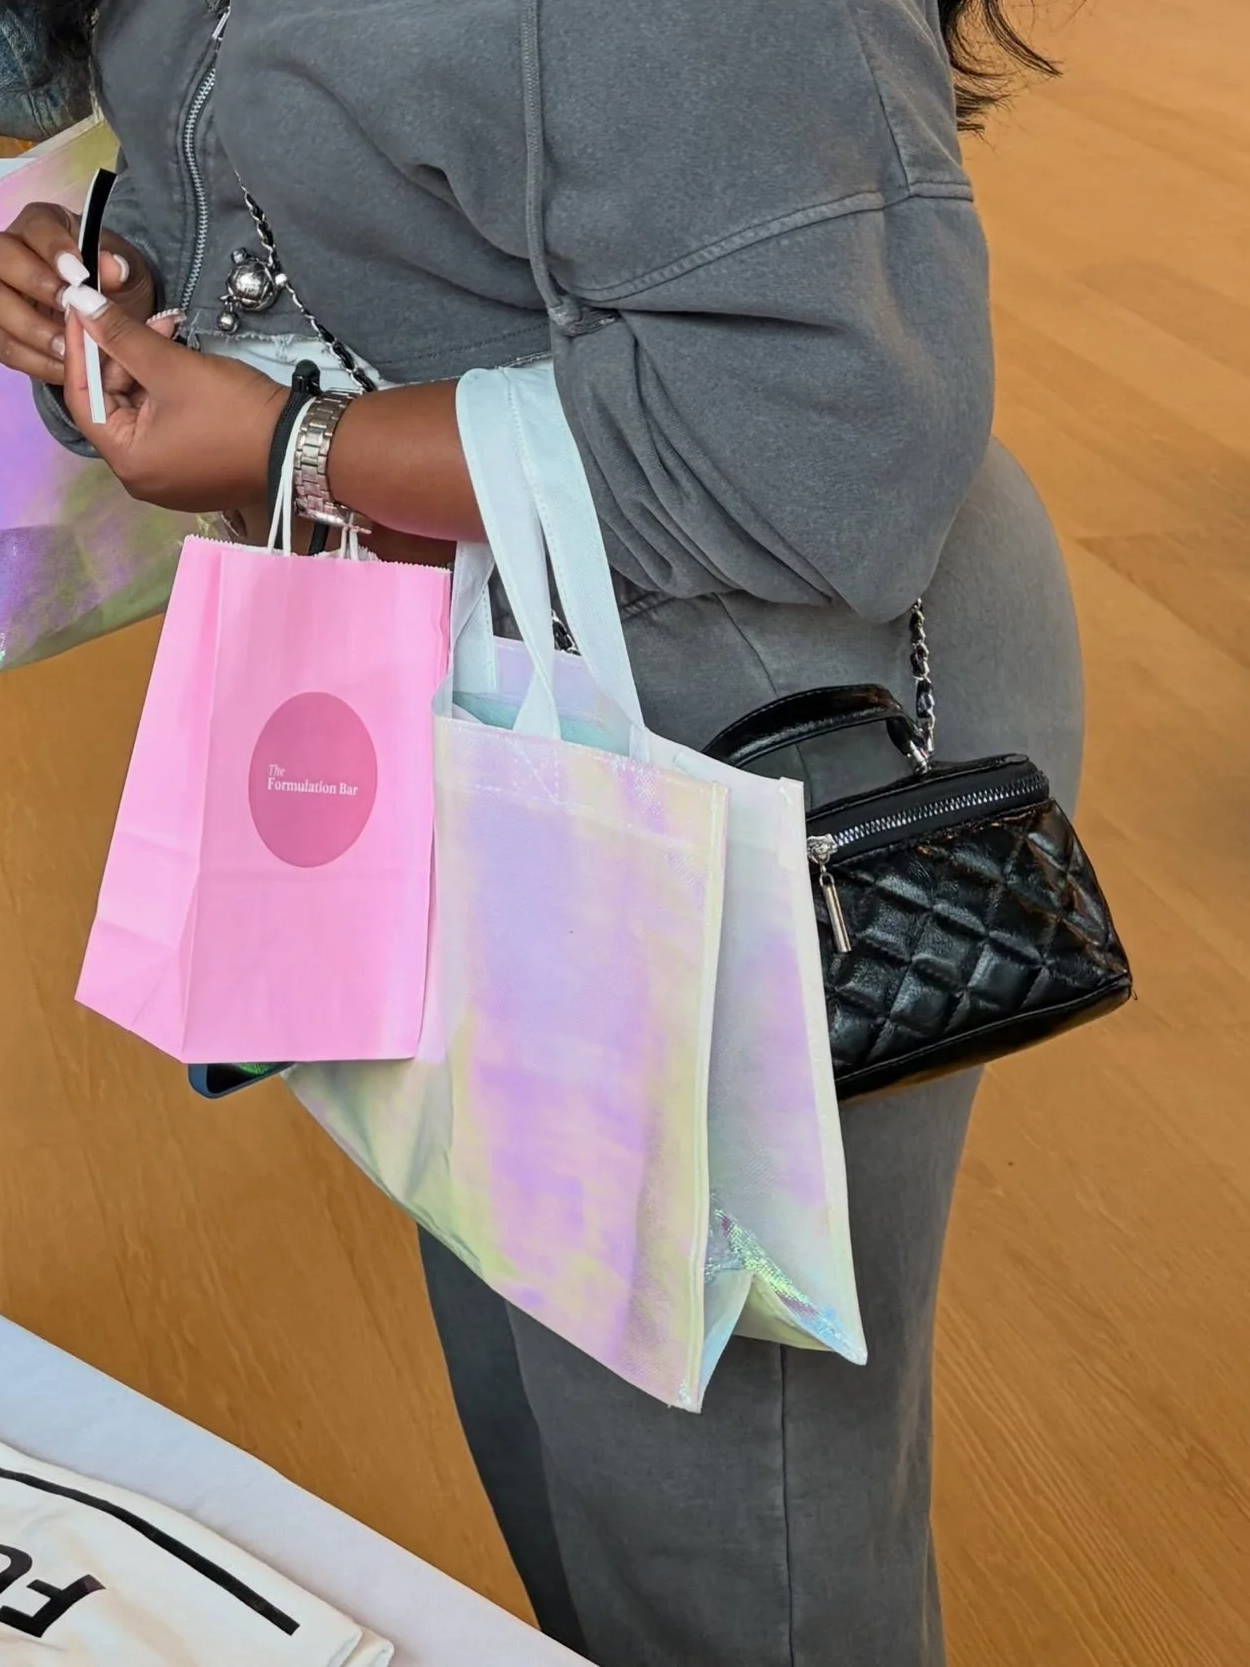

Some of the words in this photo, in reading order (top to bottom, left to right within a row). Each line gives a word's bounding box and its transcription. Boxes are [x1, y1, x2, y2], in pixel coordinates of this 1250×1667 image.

[268, 763, 286, 777] The
[267, 777, 337, 794] Formulation
[339, 782, 359, 795] Bar
